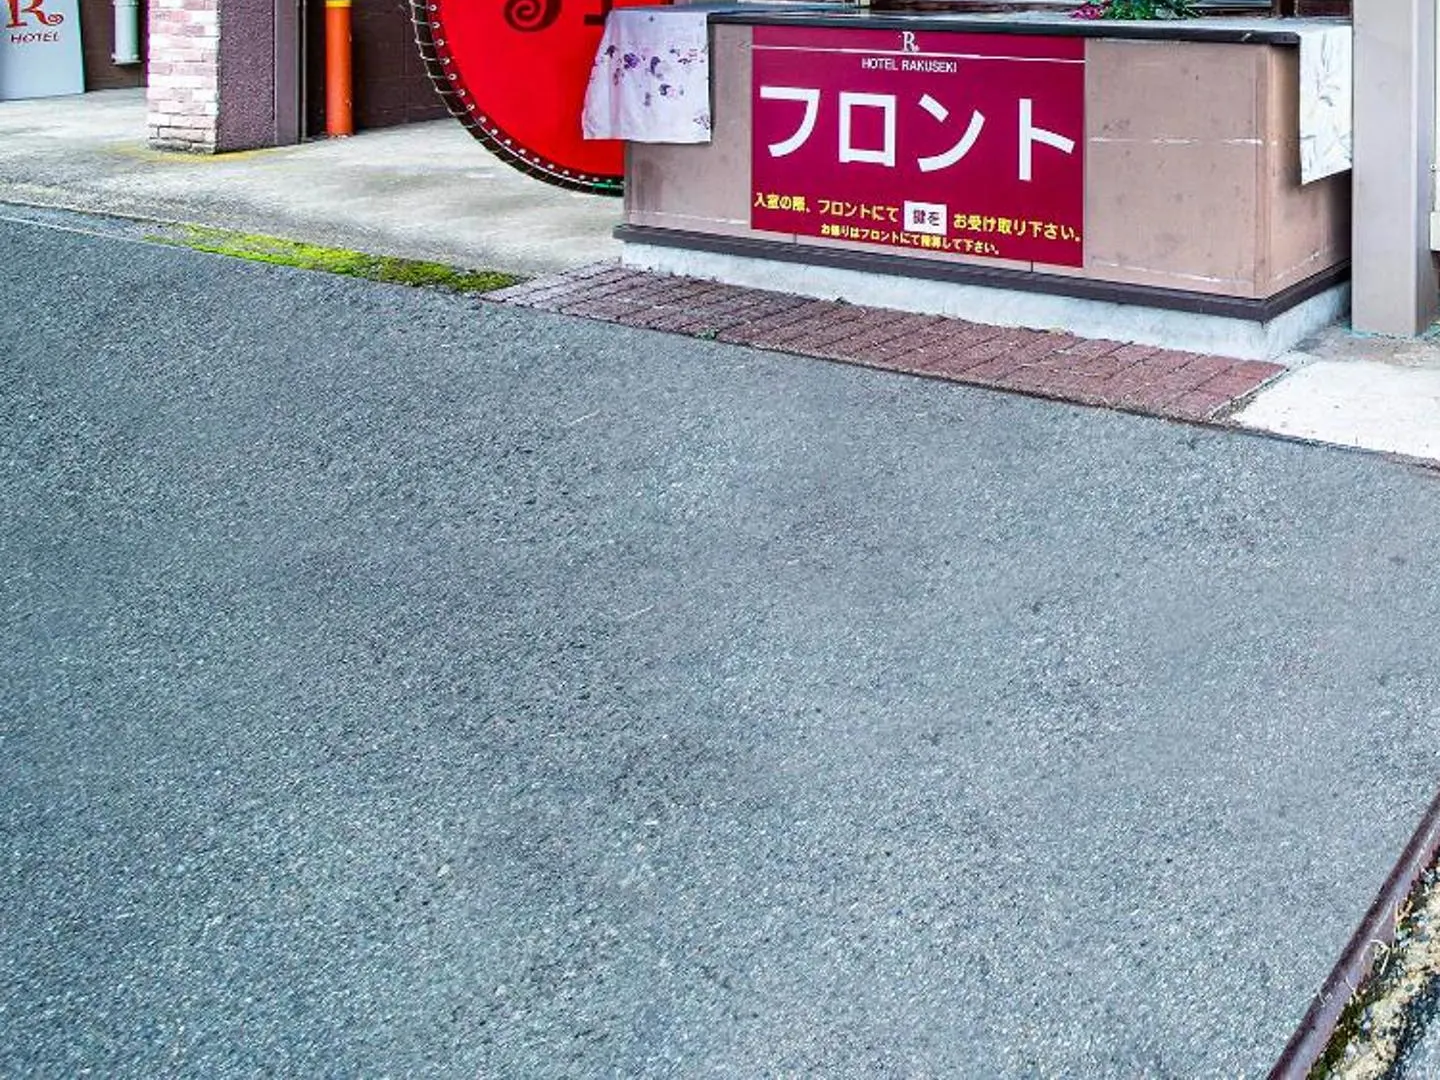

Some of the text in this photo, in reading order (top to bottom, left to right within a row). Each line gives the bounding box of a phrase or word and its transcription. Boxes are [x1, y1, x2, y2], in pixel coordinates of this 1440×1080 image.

[11, 31, 60, 43] HOTEL
[902, 31, 920, 52] R
[861, 58, 957, 73] HOTEL RAKUSEKI
[760, 86, 1076, 182] フロント
[953, 214, 1081, 242] お受け取り下さい。
